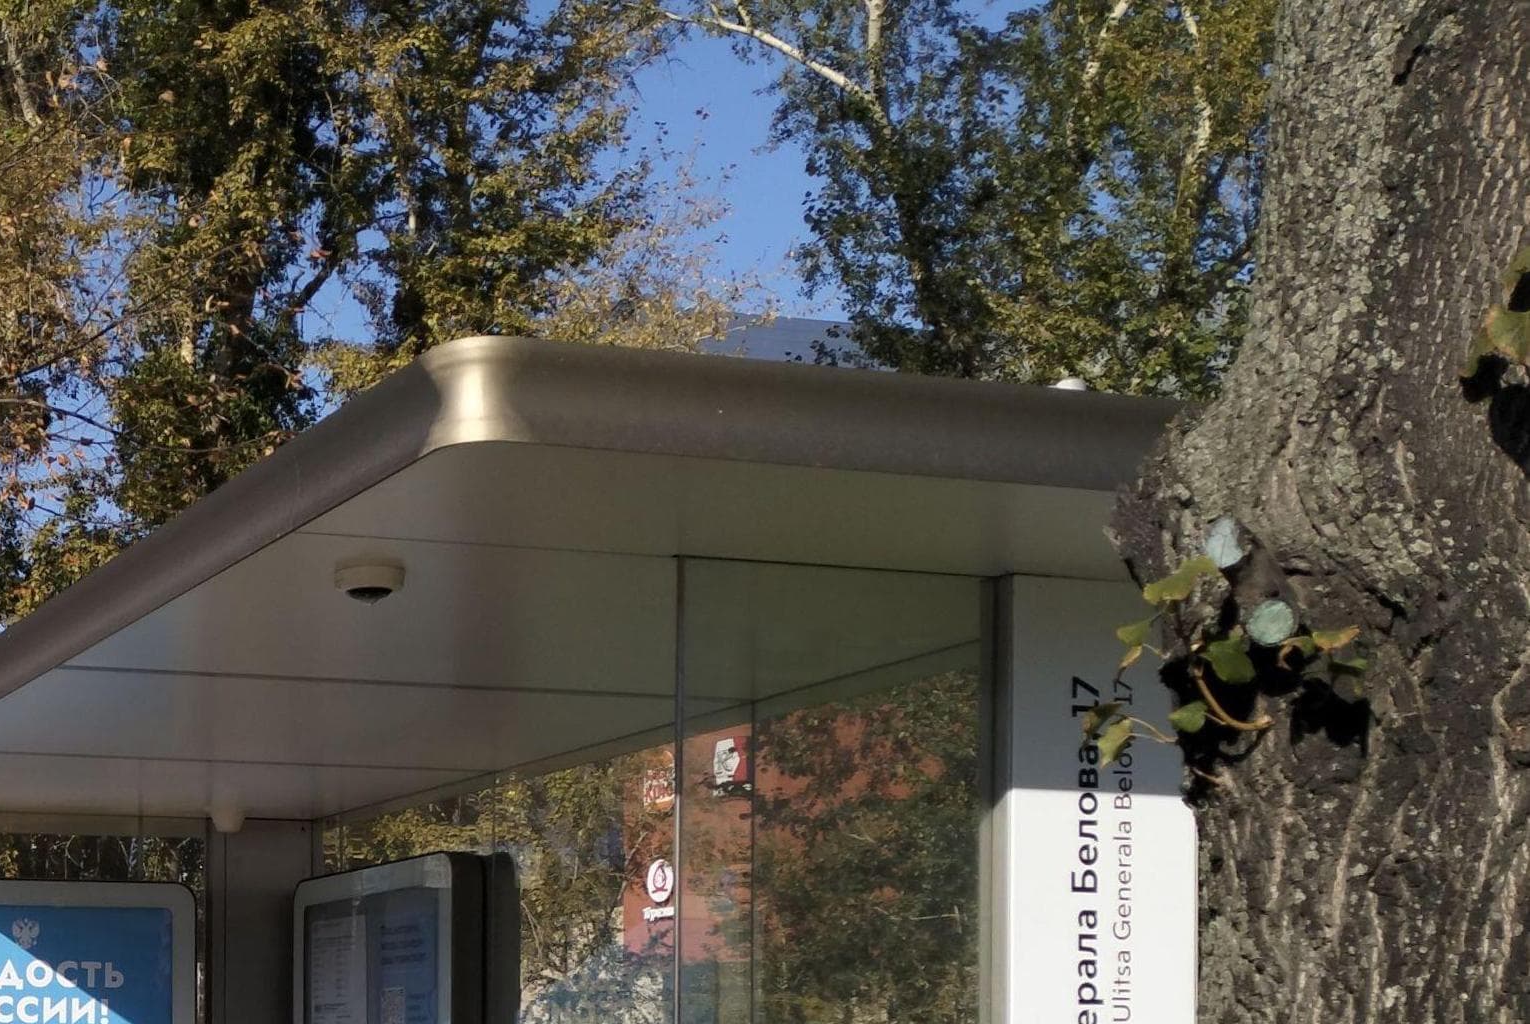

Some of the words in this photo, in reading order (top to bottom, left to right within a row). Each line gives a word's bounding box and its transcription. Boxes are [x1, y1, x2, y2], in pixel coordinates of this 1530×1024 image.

[1071, 675, 1100, 717] 17
[1113, 677, 1133, 706] 17
[1112, 820, 1132, 941] Generala
[1112, 950, 1132, 1023] Ulitsa
